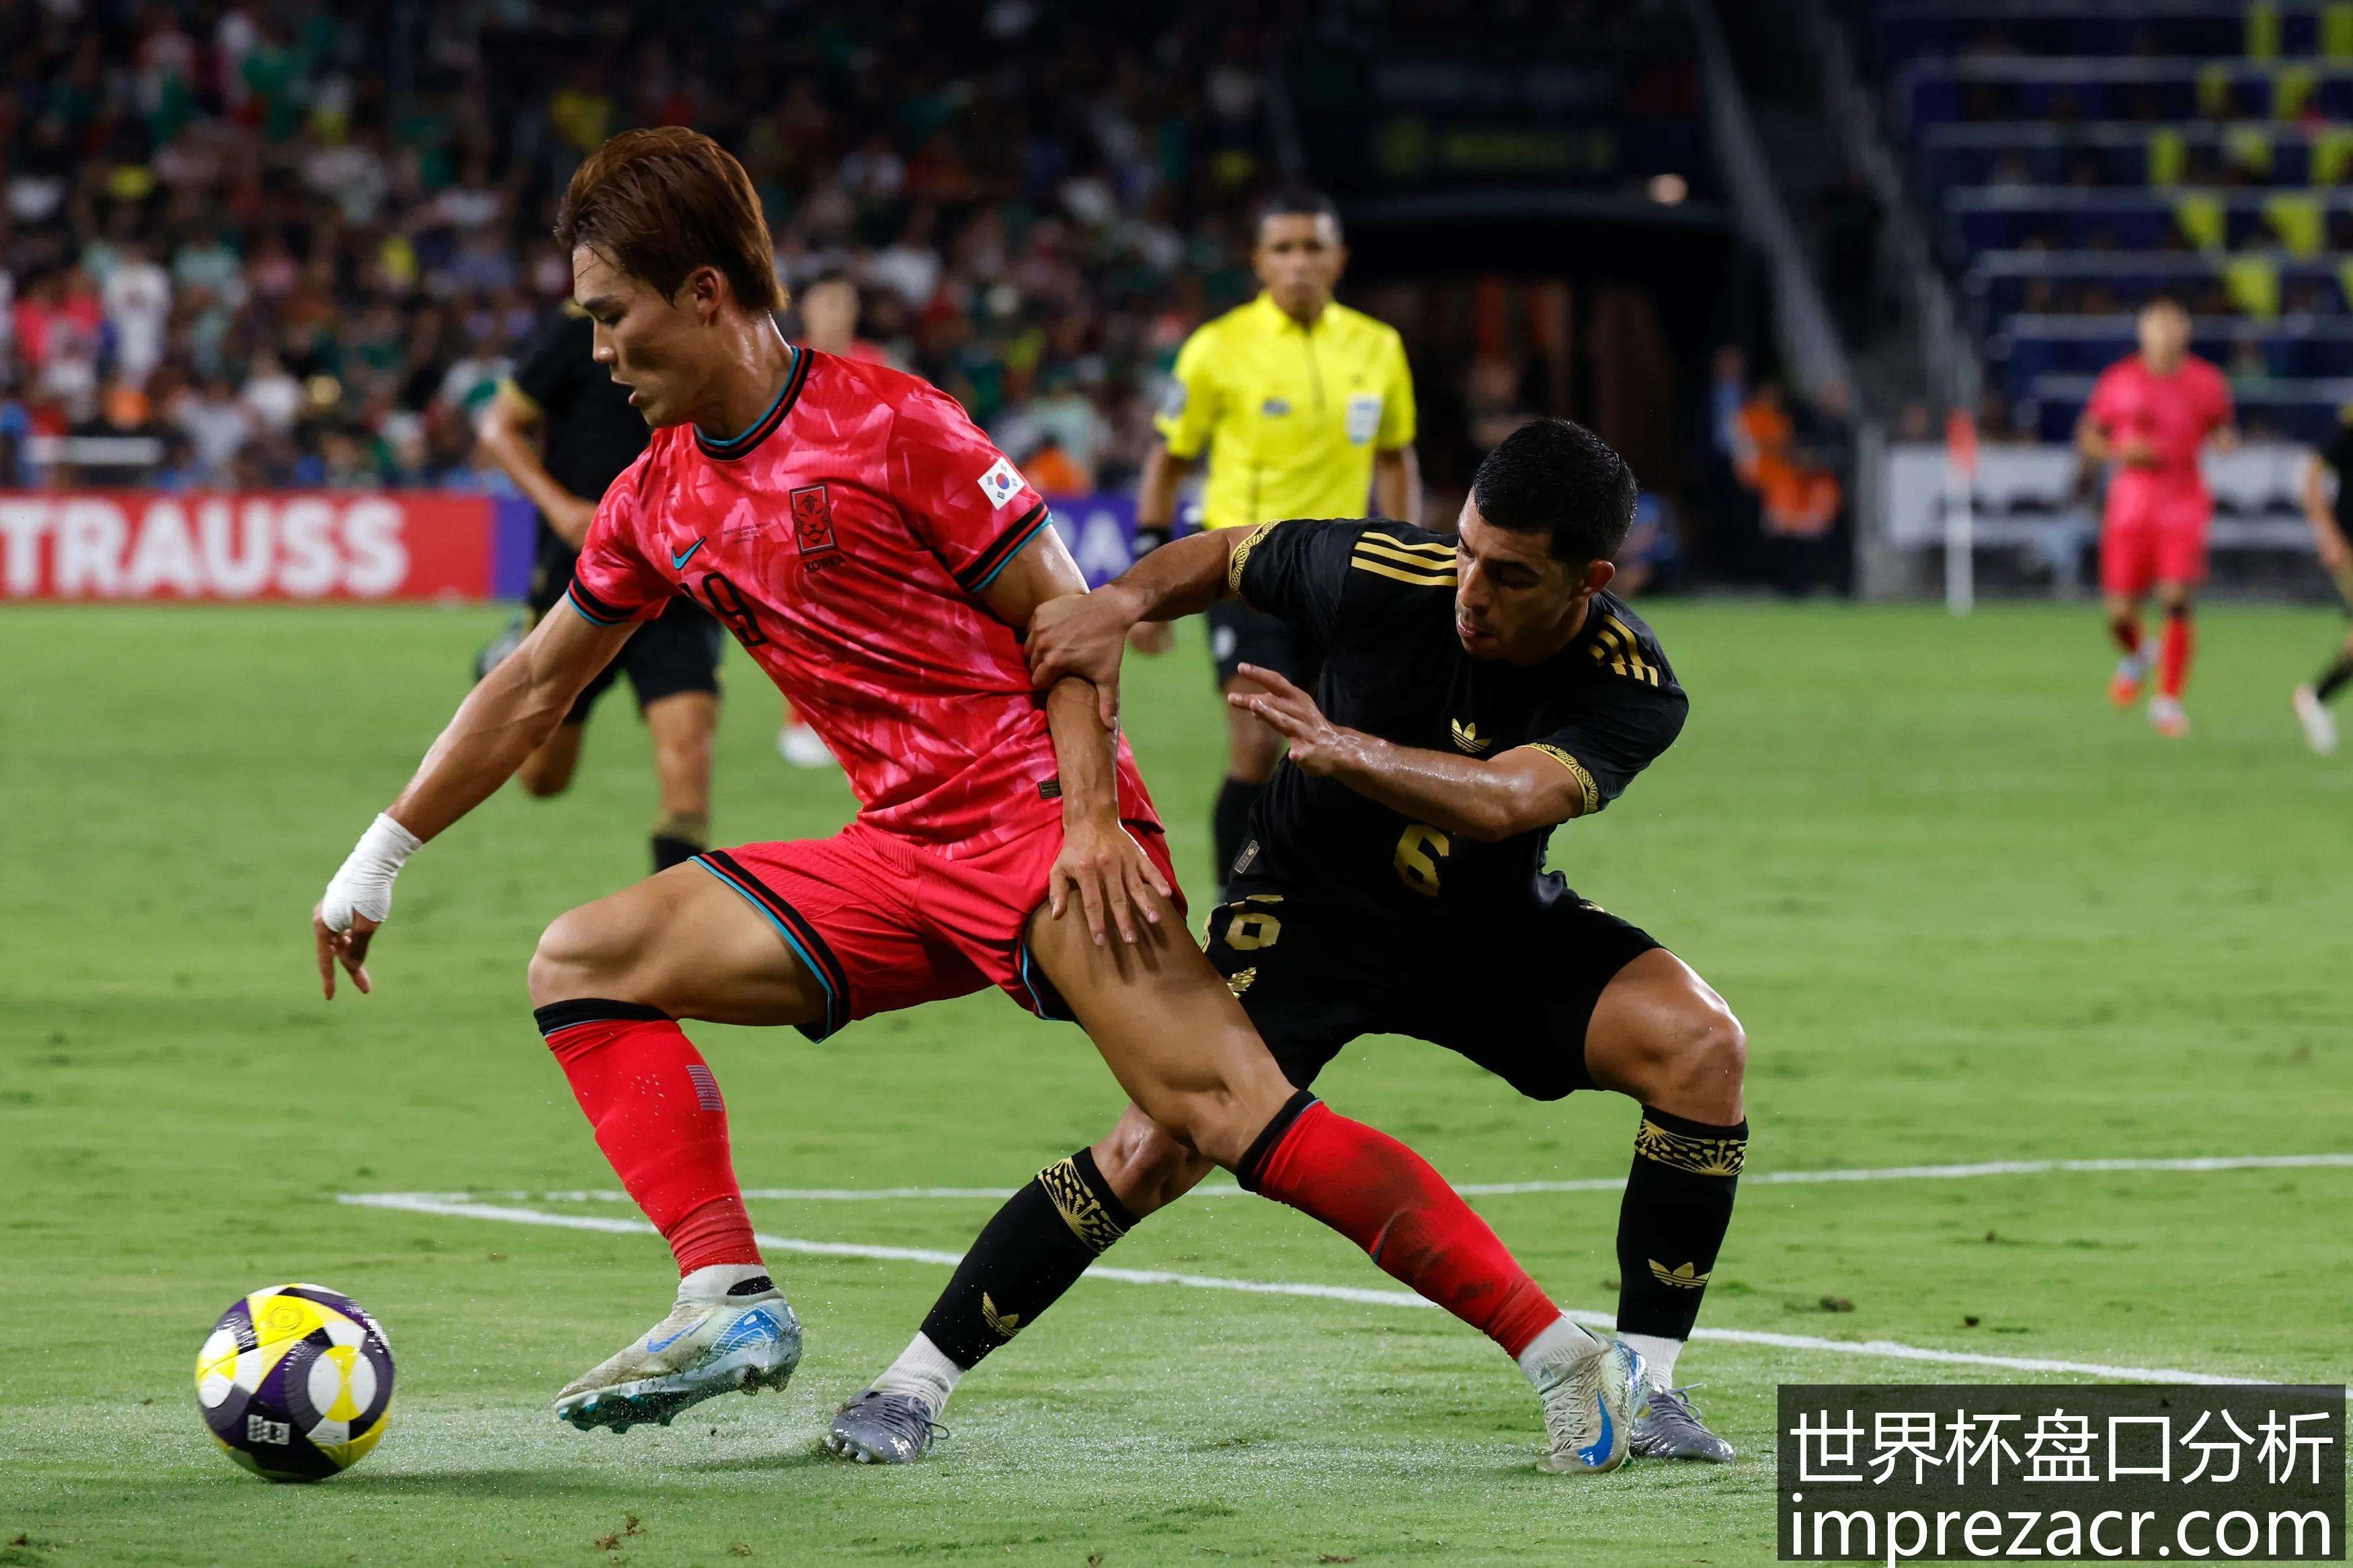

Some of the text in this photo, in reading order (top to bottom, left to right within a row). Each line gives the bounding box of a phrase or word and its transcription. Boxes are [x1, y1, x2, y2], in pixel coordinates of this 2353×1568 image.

[0, 497, 407, 599] TRAUSS
[679, 572, 768, 647] 9
[1394, 824, 1450, 897] 6
